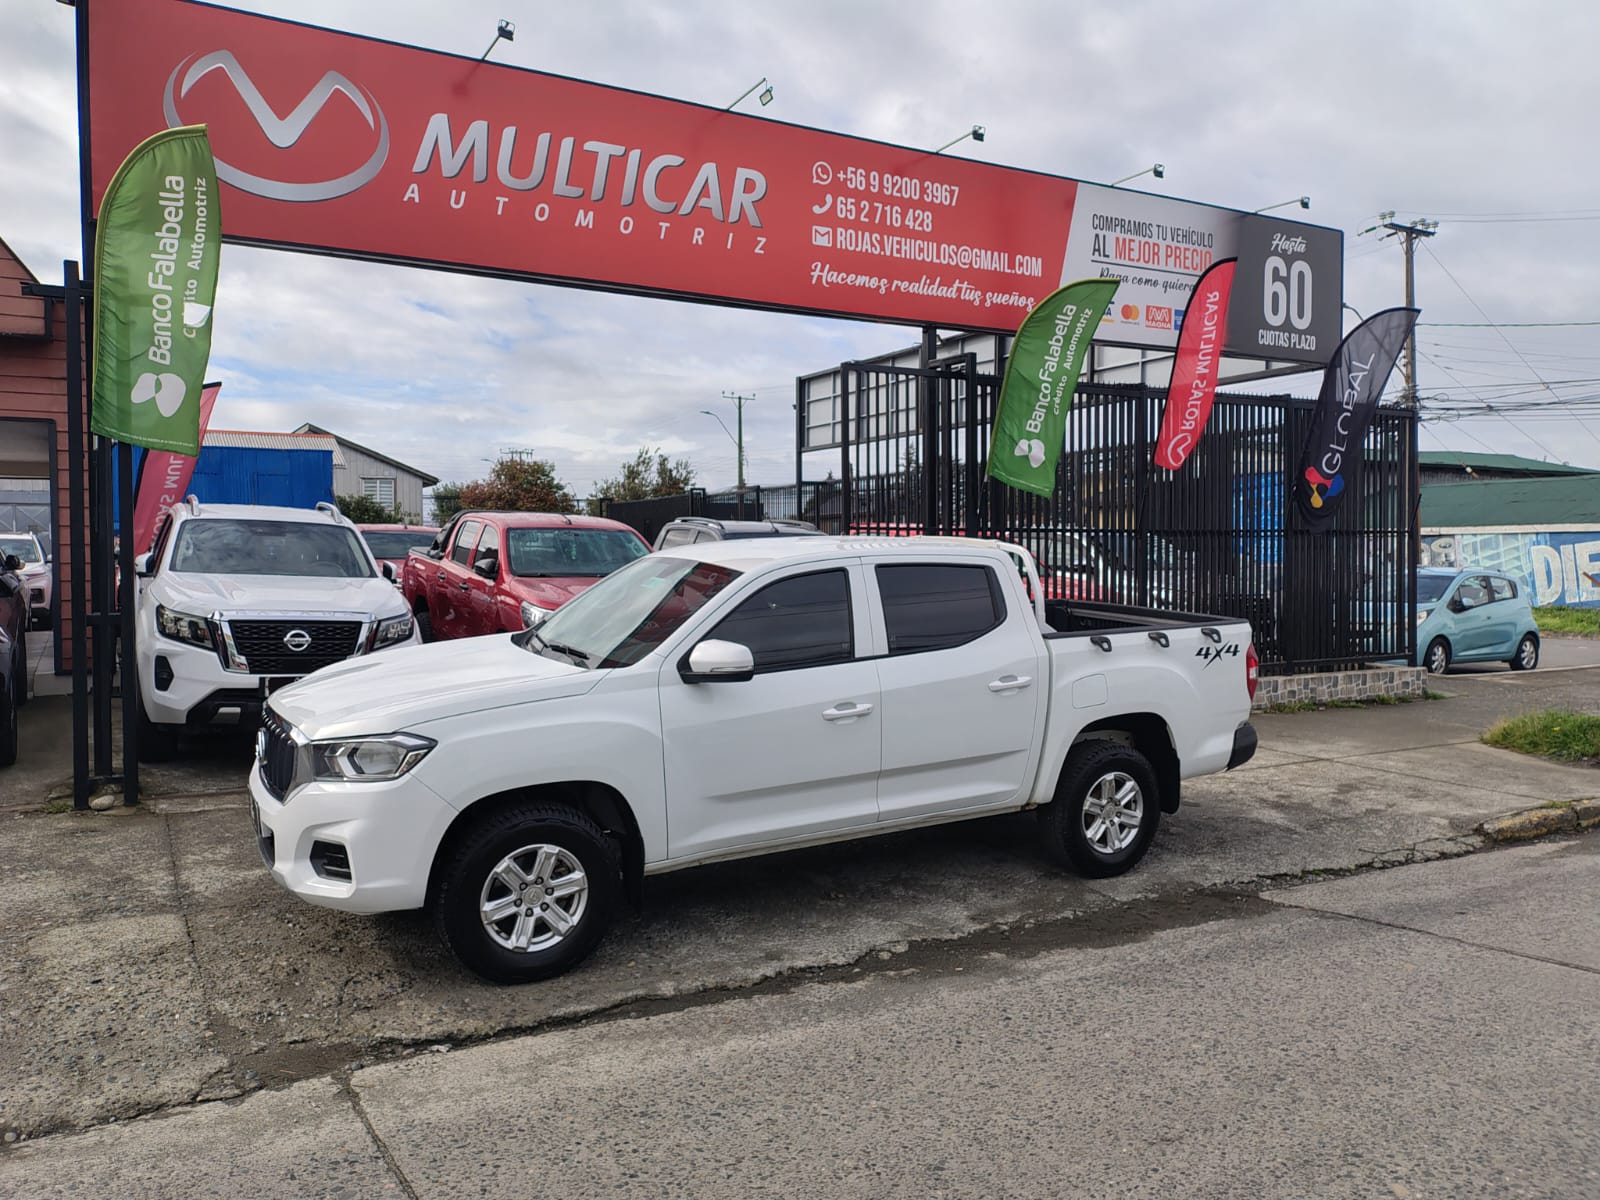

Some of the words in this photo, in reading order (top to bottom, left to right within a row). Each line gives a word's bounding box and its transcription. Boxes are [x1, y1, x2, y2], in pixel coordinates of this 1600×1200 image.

[411, 112, 768, 228] MULTICAR
[836, 166, 866, 191] +56
[869, 170, 879, 193] 9
[883, 173, 920, 200] 9200
[923, 180, 959, 207] 3967
[187, 177, 208, 270] Automotriz
[403, 182, 767, 254] AUTOMOTRIZ
[836, 196, 856, 220] 65
[860, 200, 869, 222] 2
[873, 202, 901, 227] 716
[905, 208, 932, 232] 428
[1091, 213, 1153, 239] COMPRAMOS
[1156, 224, 1168, 241] TU
[1170, 226, 1214, 249] VEHÍCULO
[836, 227, 1043, 277] ROJAS.VEHICULOS@GMAIL.COM
[1091, 233, 1110, 258] AL
[1114, 236, 1160, 266] MEJOR
[1164, 244, 1213, 272] PRECIO
[1270, 232, 1308, 255] Hasta
[148, 175, 185, 365] BancoFalabella
[810, 261, 890, 294] Hacemos
[891, 275, 958, 300] realidad
[955, 281, 983, 306] tus
[985, 291, 1036, 312] sueños
[1131, 275, 1160, 289] como
[1263, 255, 1313, 330] 60
[1063, 308, 1094, 370] Automotriz
[1258, 329, 1289, 348] CUOTAS
[1290, 333, 1316, 351] PLAZO
[1026, 304, 1078, 434] BancoFalabella
[1322, 353, 1376, 475] GLOBAL
